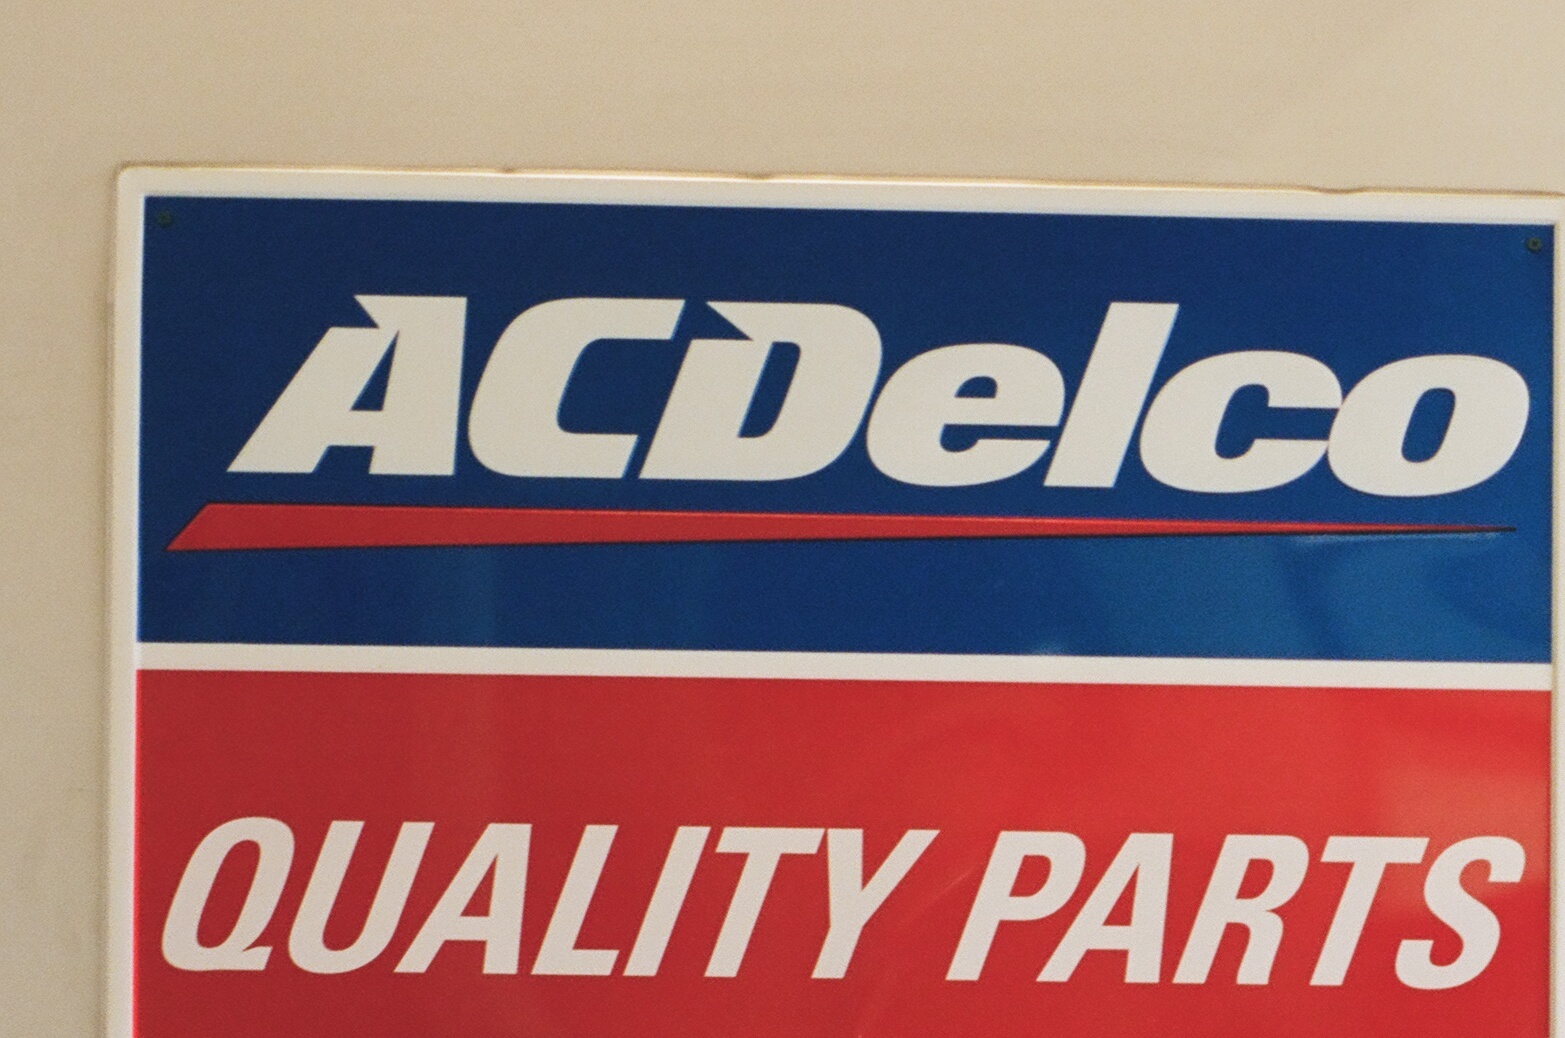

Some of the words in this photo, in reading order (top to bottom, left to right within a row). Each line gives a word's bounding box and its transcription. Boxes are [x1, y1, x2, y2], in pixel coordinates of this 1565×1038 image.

[227, 295, 1532, 498] ACDelco
[161, 816, 939, 979] QUALITY
[945, 829, 1527, 990] PARTS
